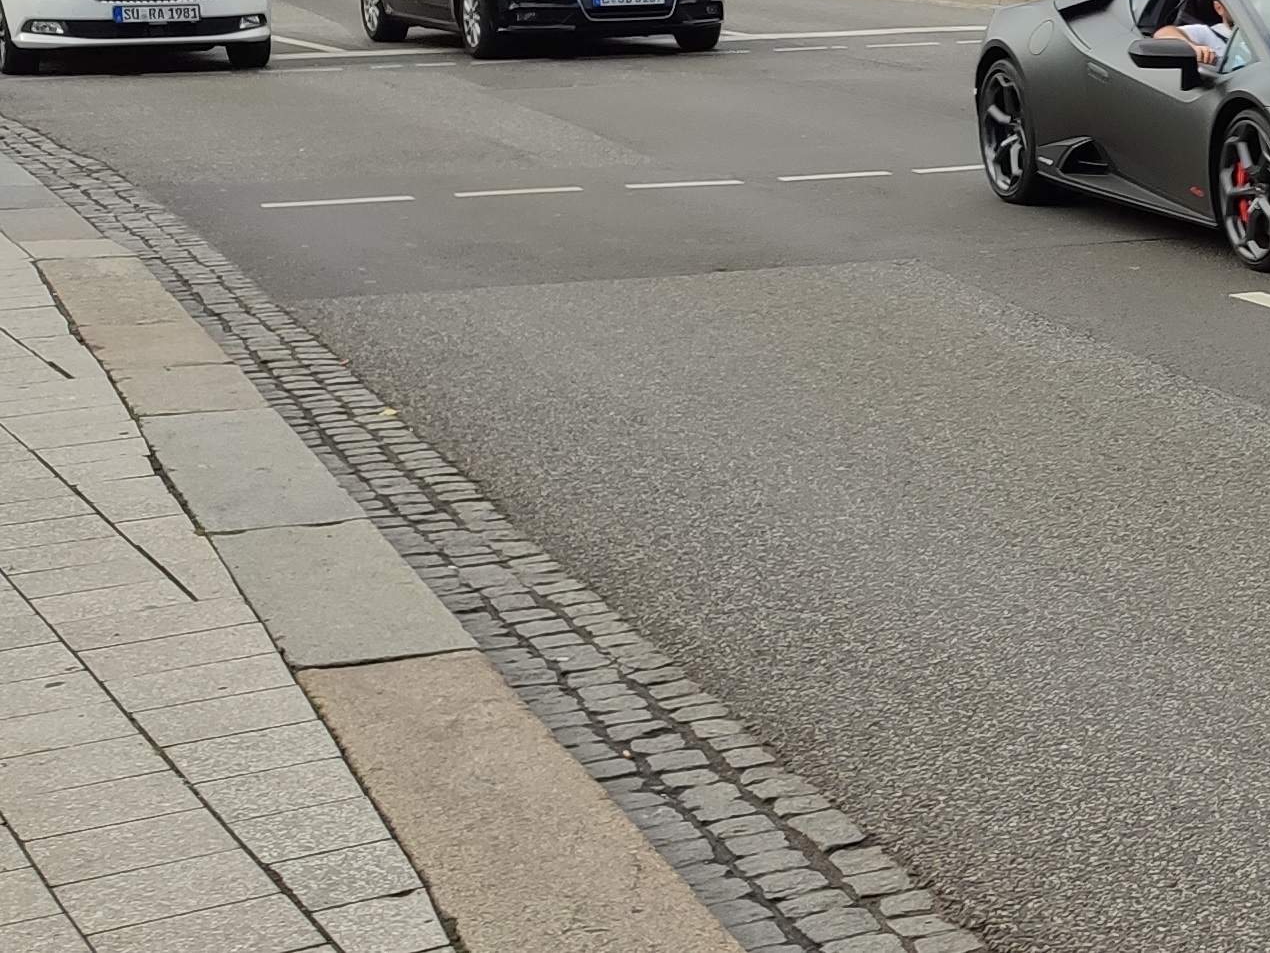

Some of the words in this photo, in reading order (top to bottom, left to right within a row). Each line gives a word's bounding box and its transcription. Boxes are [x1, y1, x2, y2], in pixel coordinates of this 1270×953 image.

[123, 8, 140, 20] SU
[148, 8, 165, 20] RA
[168, 7, 198, 20] 1981
